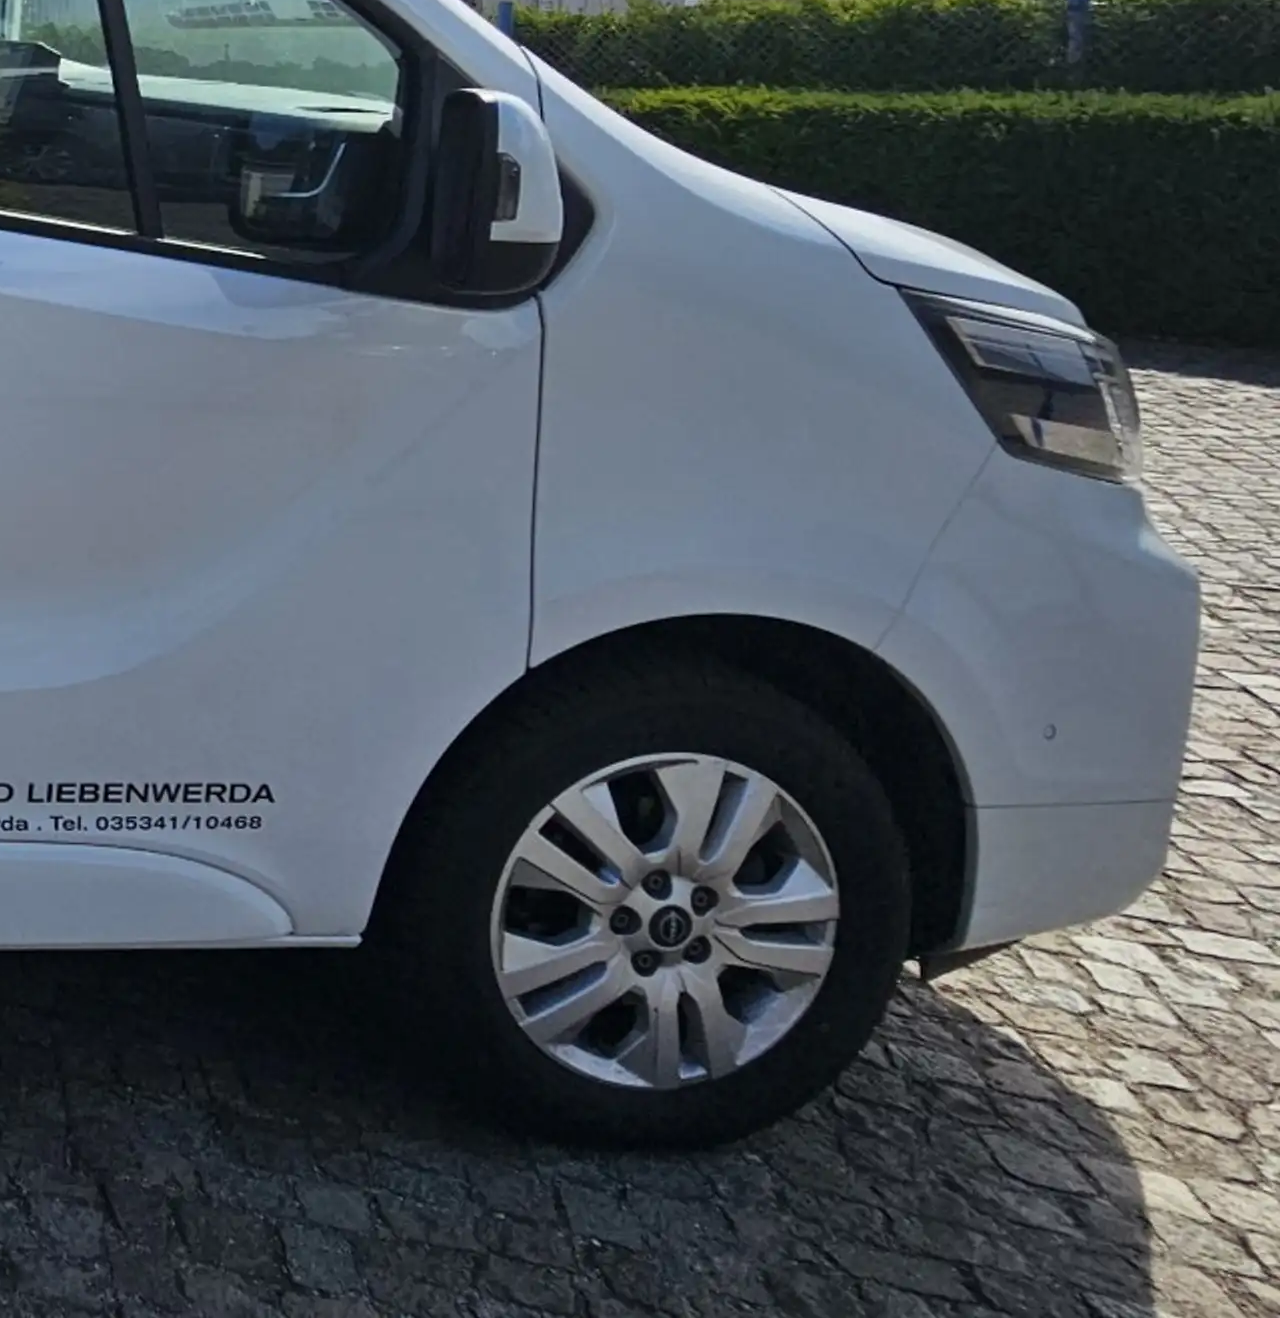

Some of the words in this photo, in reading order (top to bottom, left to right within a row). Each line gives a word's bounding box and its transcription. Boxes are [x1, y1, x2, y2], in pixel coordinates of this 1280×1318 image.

[27, 782, 276, 804] LIEBENWERDA
[49, 815, 88, 832] Tel.
[95, 815, 262, 831] 035341/10468
